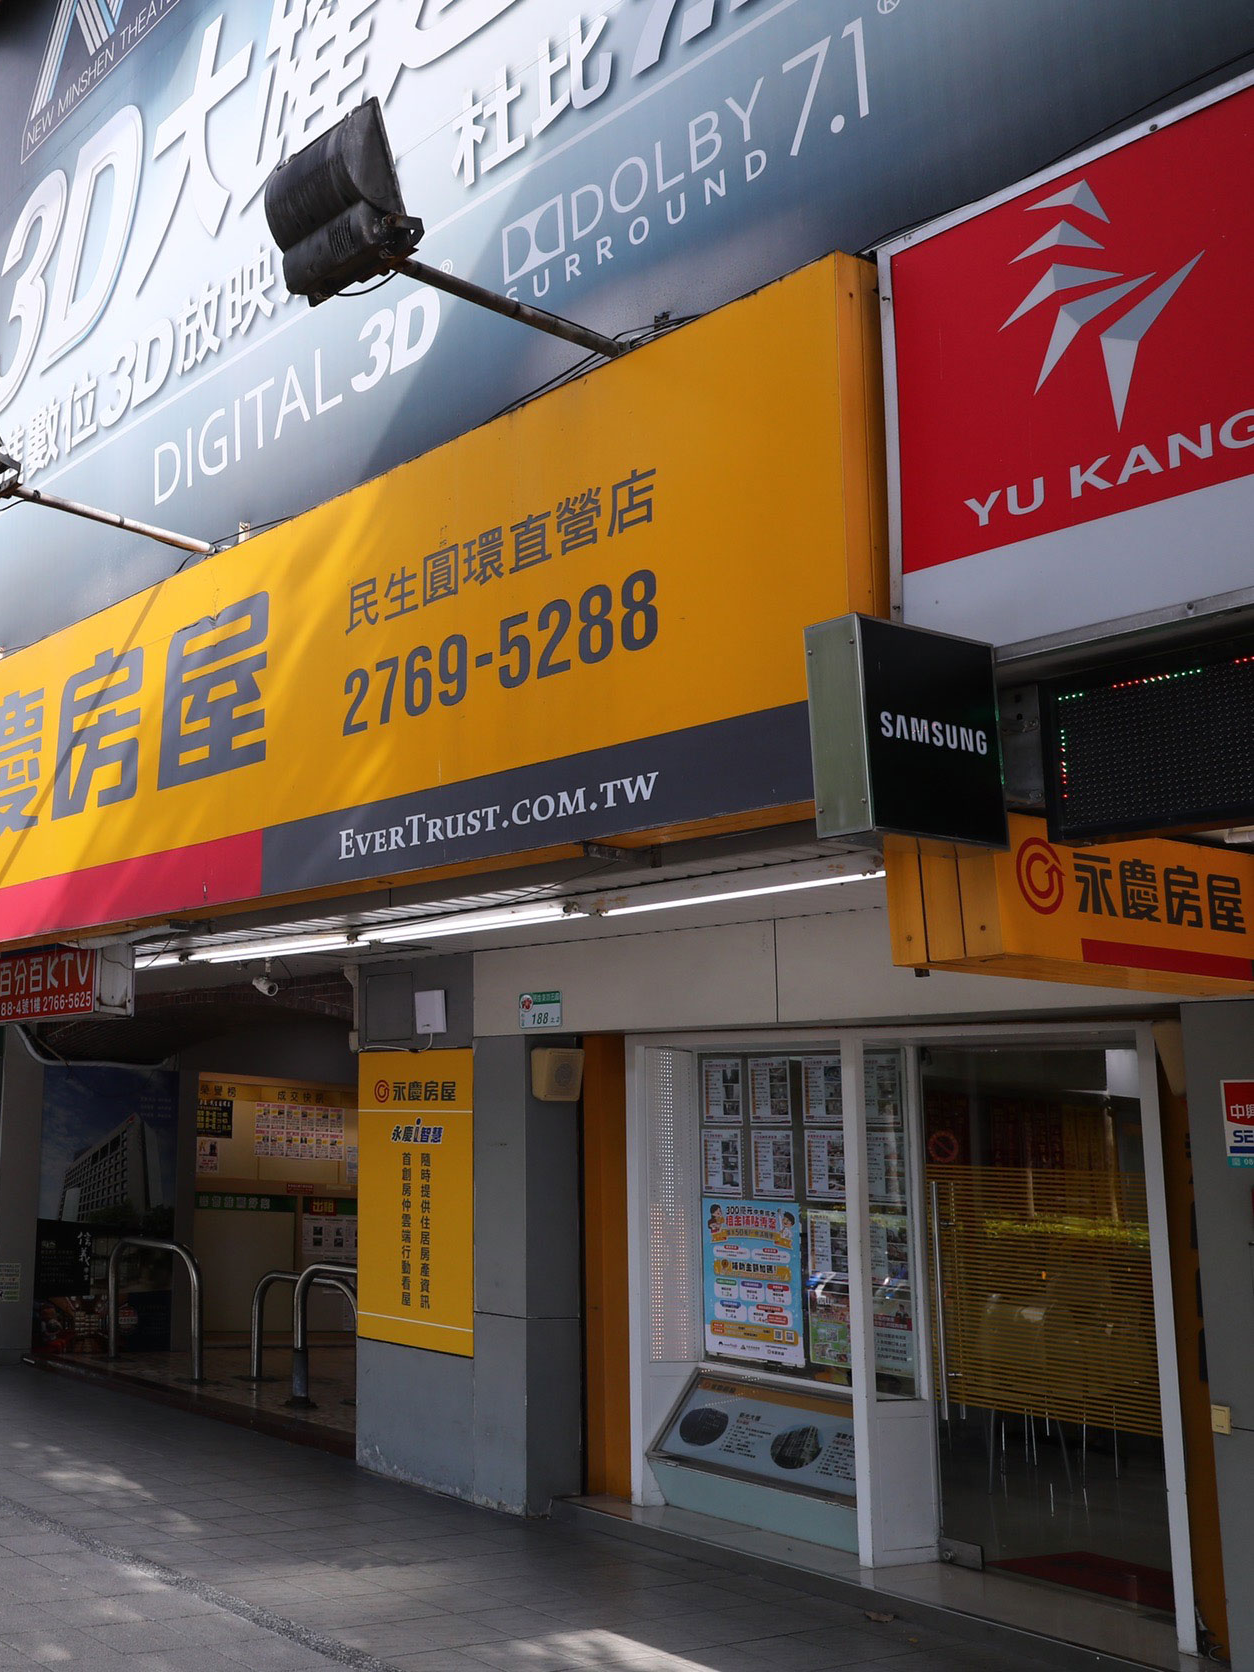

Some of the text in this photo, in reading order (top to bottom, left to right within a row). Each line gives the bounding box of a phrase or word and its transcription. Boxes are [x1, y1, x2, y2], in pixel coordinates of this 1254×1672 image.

[26, 0, 180, 150] NEW MINSHEN THEA
[570, 17, 870, 242] DOLBY 7.1
[154, 286, 440, 506] DIGITAL 3D
[963, 408, 1254, 527] YU KANG
[344, 467, 657, 636] 民生圓環直營店
[342, 569, 658, 736] 2769-5288
[880, 710, 988, 755] SAMSUNG
[1072, 851, 1247, 935] 永慶房屋
[0, 950, 92, 998] 百分百KTV
[392, 1080, 457, 1102] 永慶房屋
